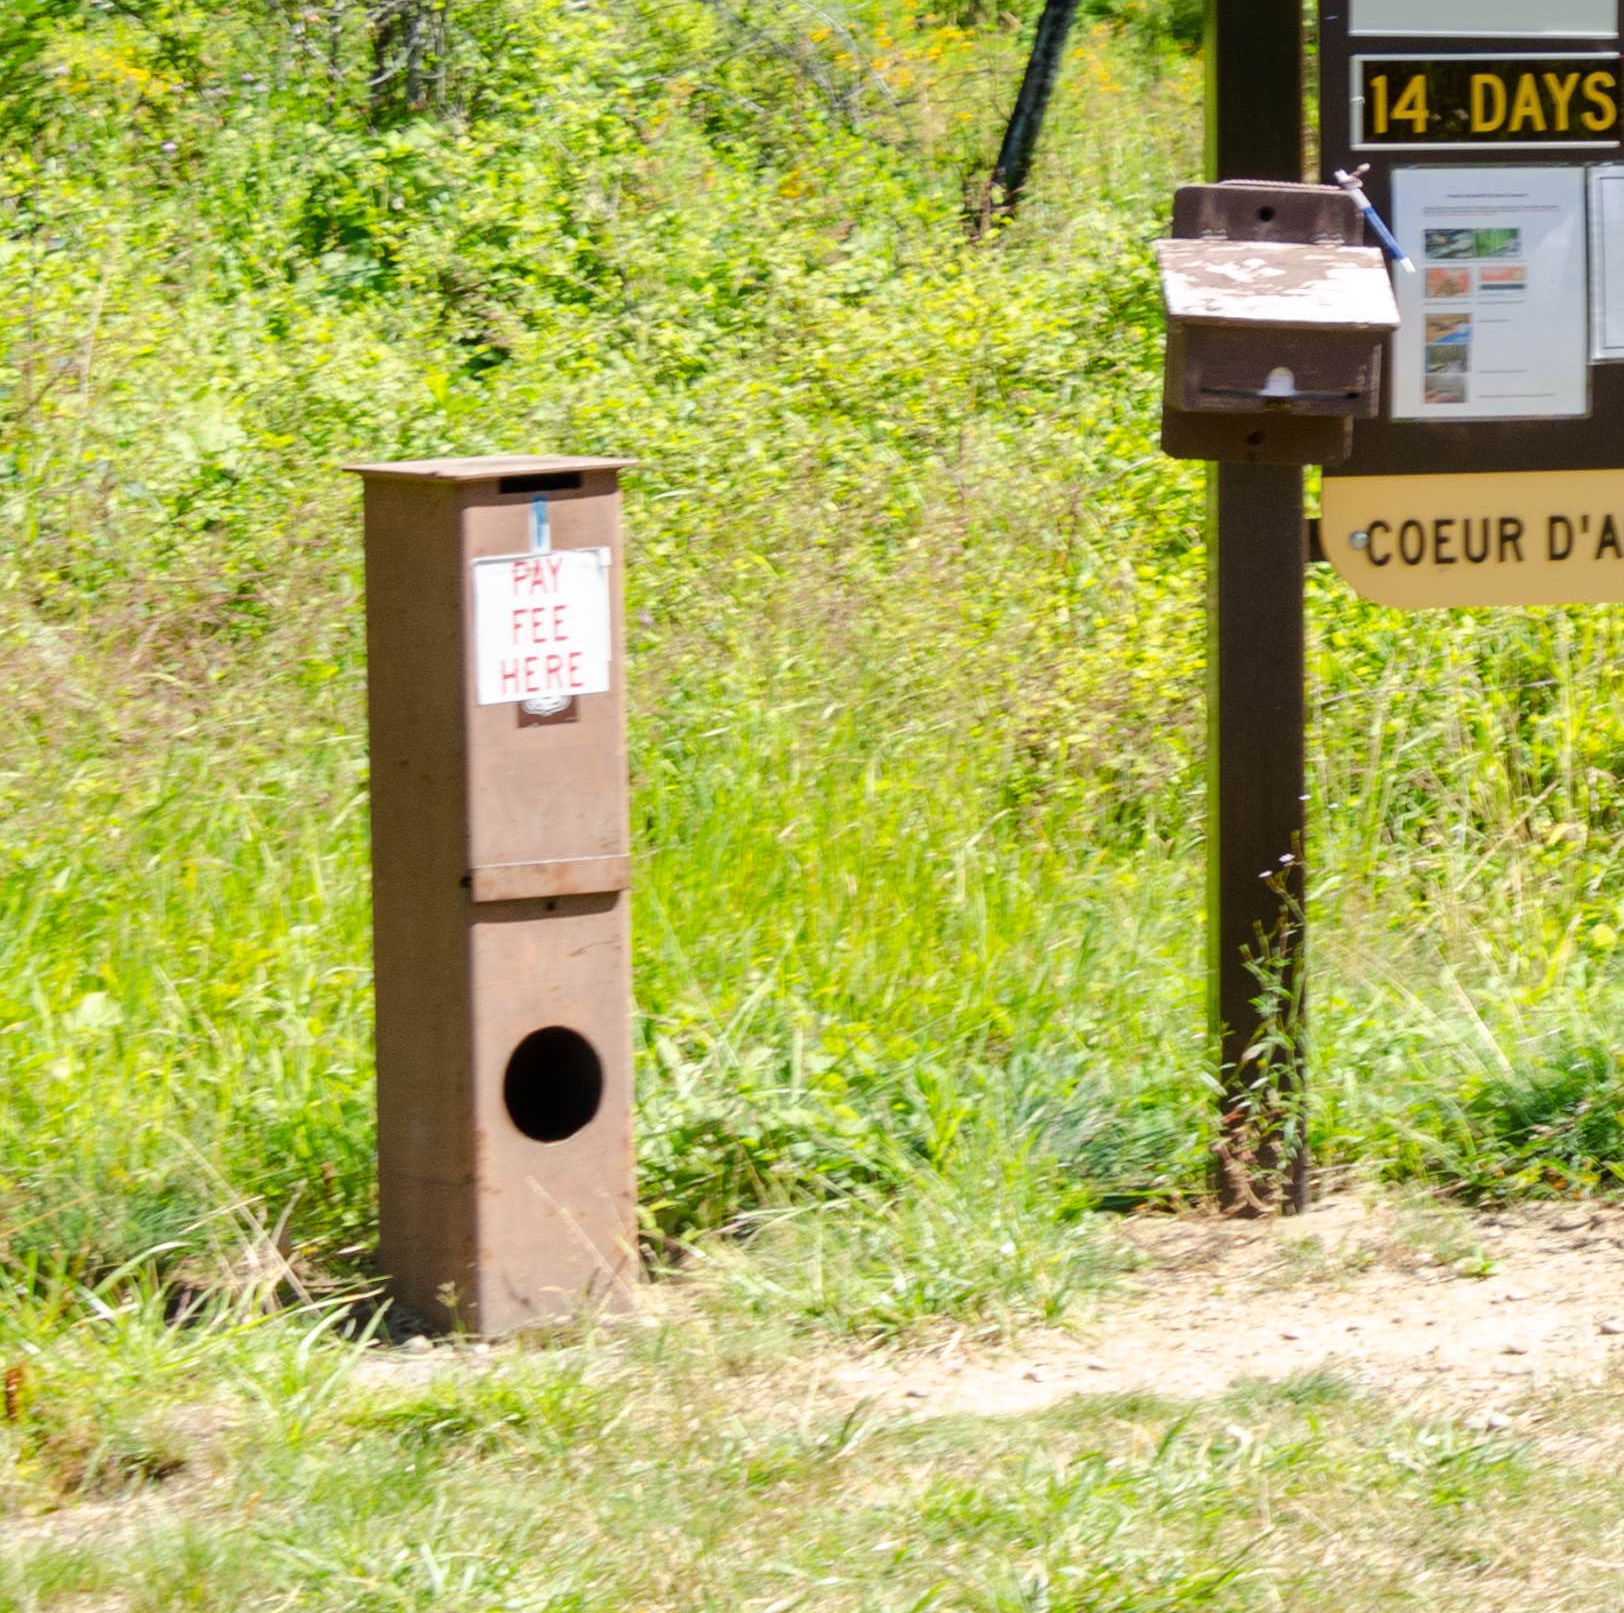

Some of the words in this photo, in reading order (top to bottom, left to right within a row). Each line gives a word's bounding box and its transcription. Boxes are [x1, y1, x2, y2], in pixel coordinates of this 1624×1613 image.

[1370, 74, 1430, 134] 14
[1471, 72, 1618, 133] DAYS
[1366, 516, 1525, 567] COEUR
[512, 556, 564, 597] PAY
[512, 604, 569, 646] FEE
[500, 651, 585, 696] HERE
